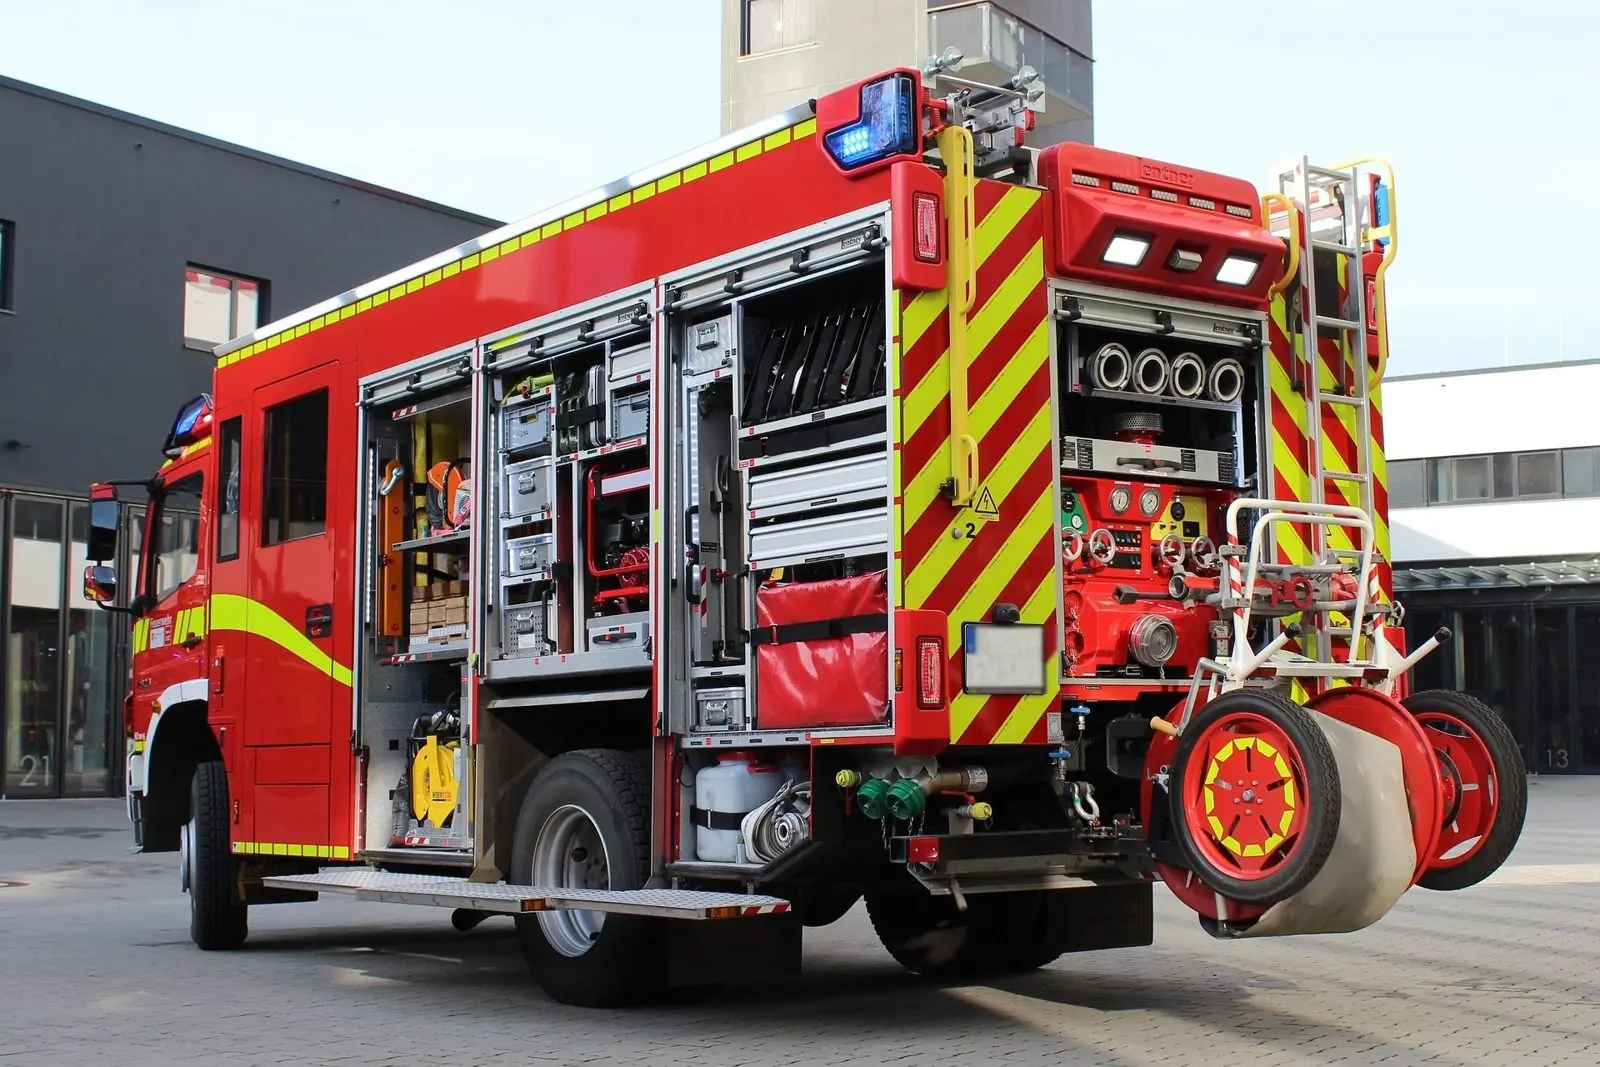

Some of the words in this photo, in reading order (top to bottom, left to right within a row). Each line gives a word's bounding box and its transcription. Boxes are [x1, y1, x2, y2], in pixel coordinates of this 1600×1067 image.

[966, 522, 977, 538] 2
[1547, 749, 1569, 768] 13
[20, 754, 49, 786] 21
